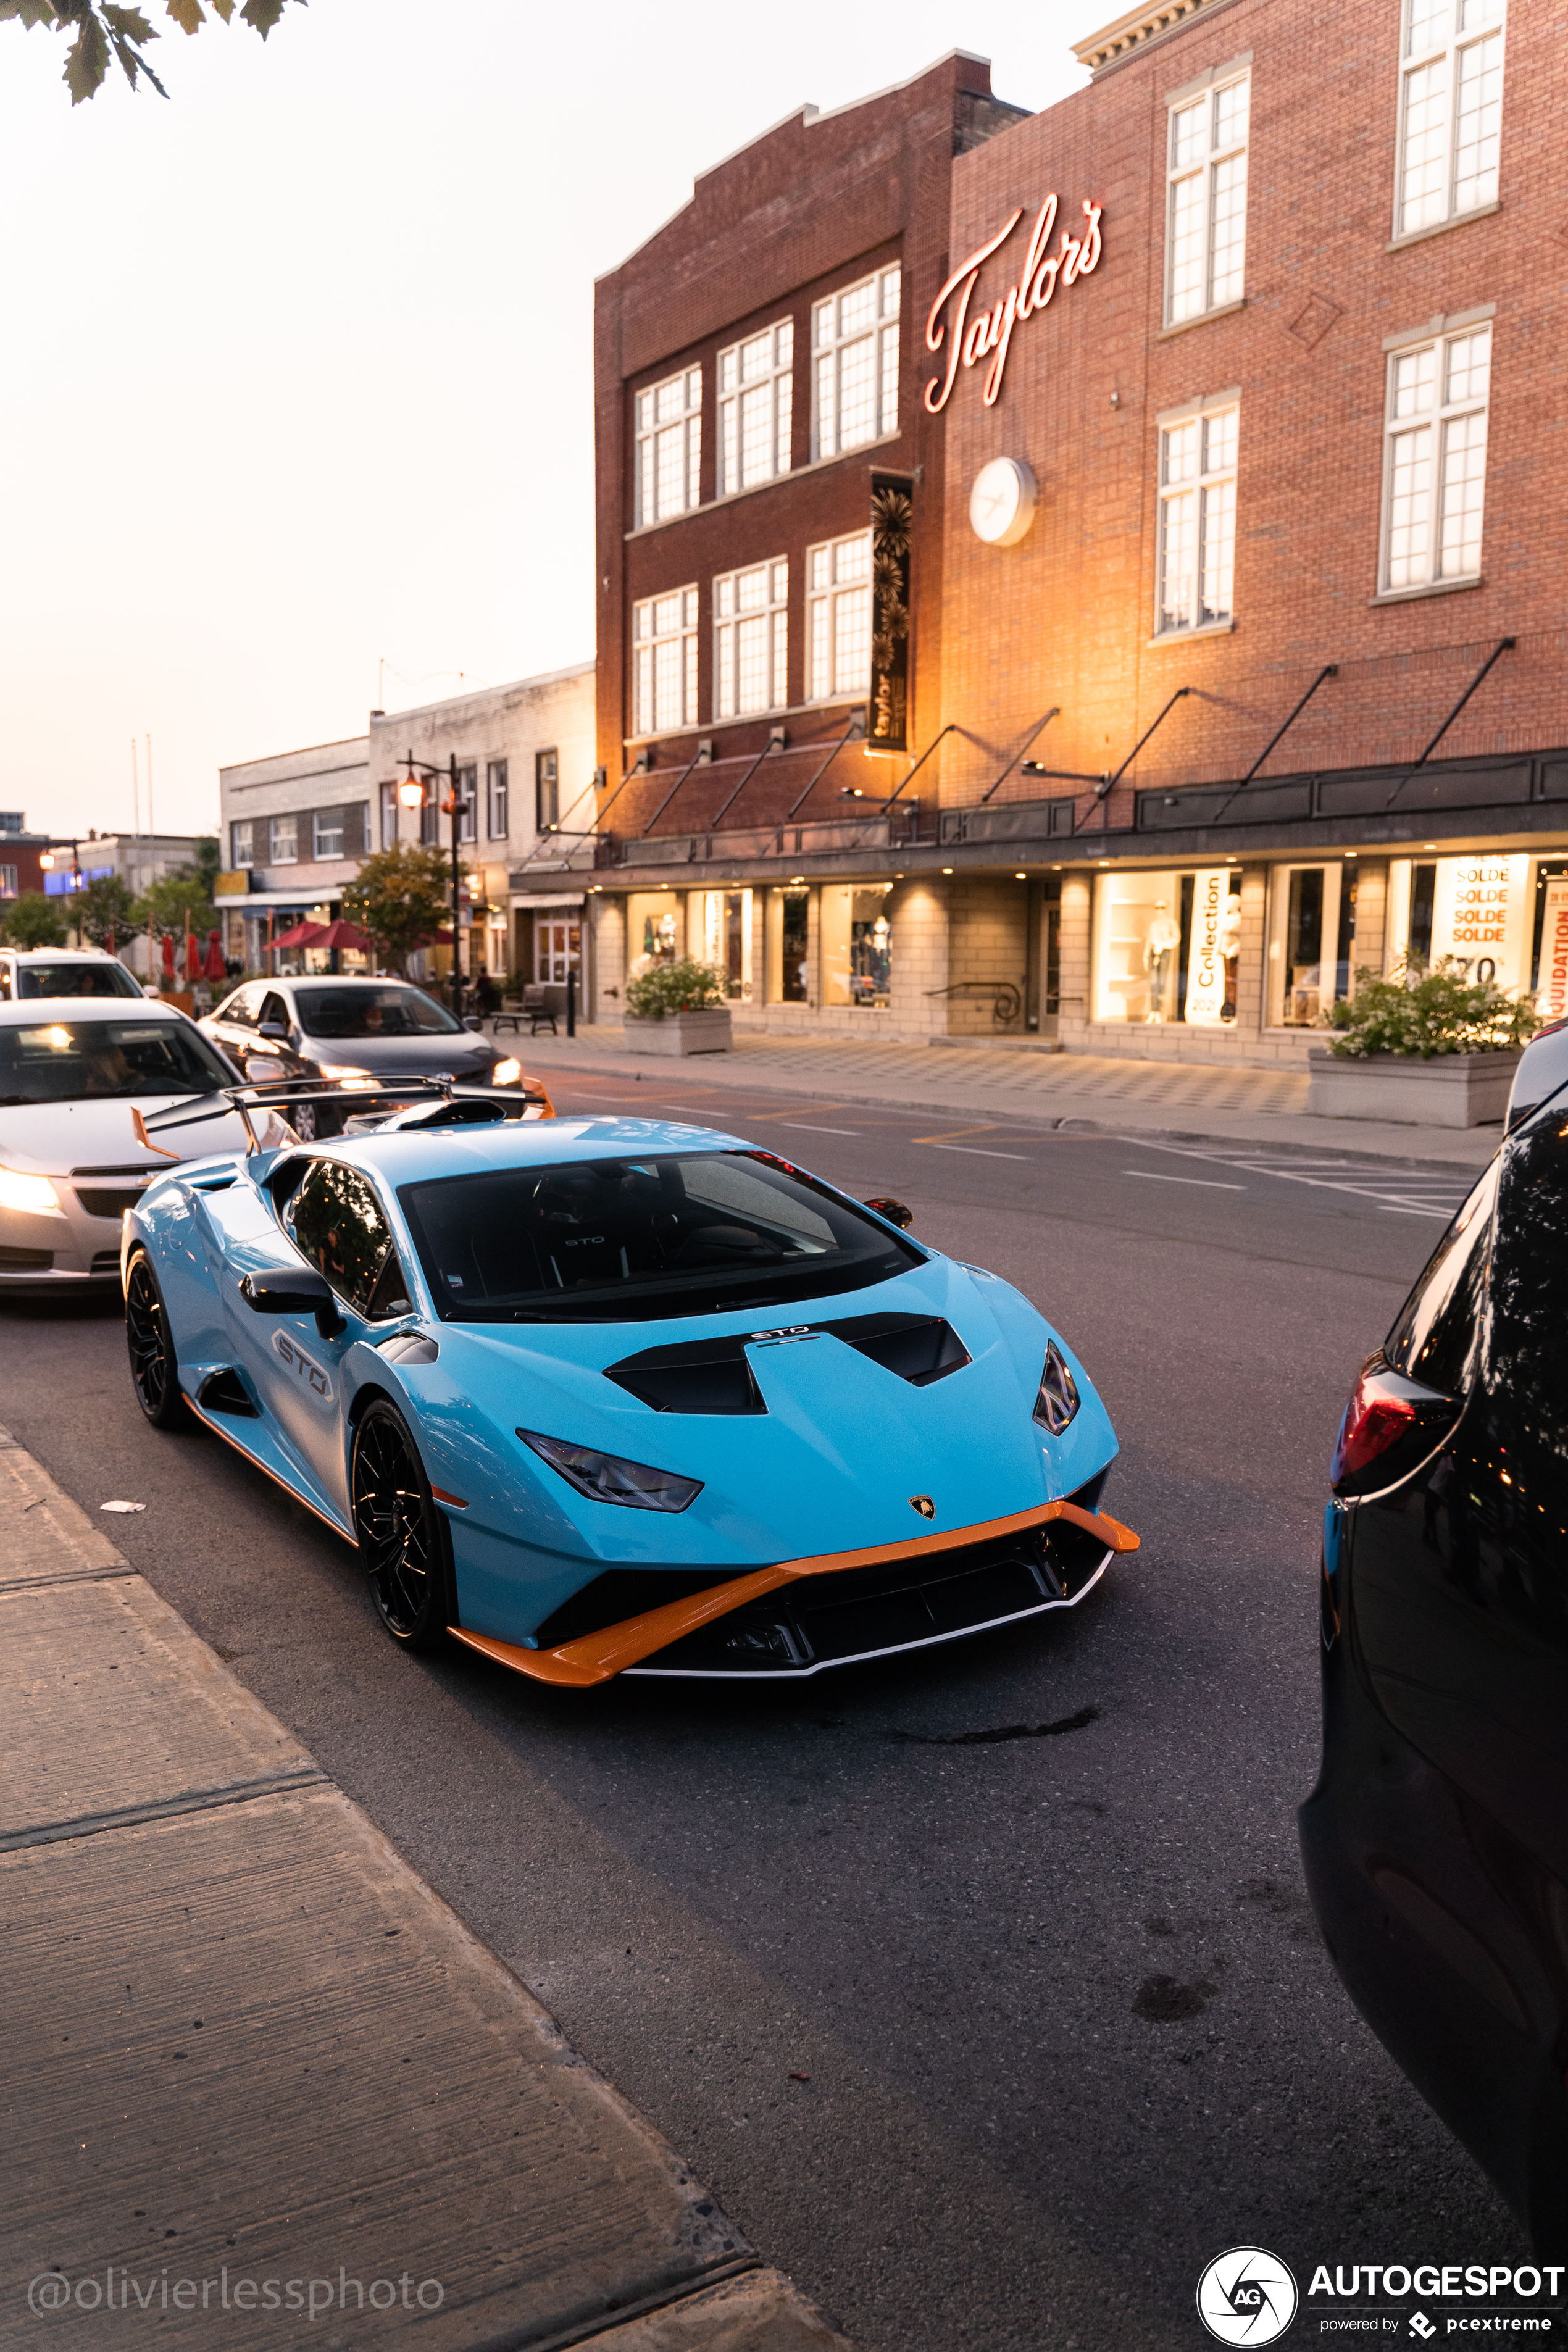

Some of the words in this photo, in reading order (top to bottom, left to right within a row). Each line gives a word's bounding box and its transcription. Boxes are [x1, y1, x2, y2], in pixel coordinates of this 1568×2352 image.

[874, 673, 892, 737] taylor
[1457, 869, 1508, 882] SOLDE
[1456, 889, 1508, 903] SOLDE
[1454, 909, 1506, 923] SOLDE
[1199, 877, 1220, 987] Collection
[1453, 928, 1504, 942] SOLDE
[1547, 911, 1568, 1020] IQUIDATION
[565, 1236, 604, 1246] STO
[751, 1326, 809, 1339] STO
[279, 1337, 326, 1395] STO
